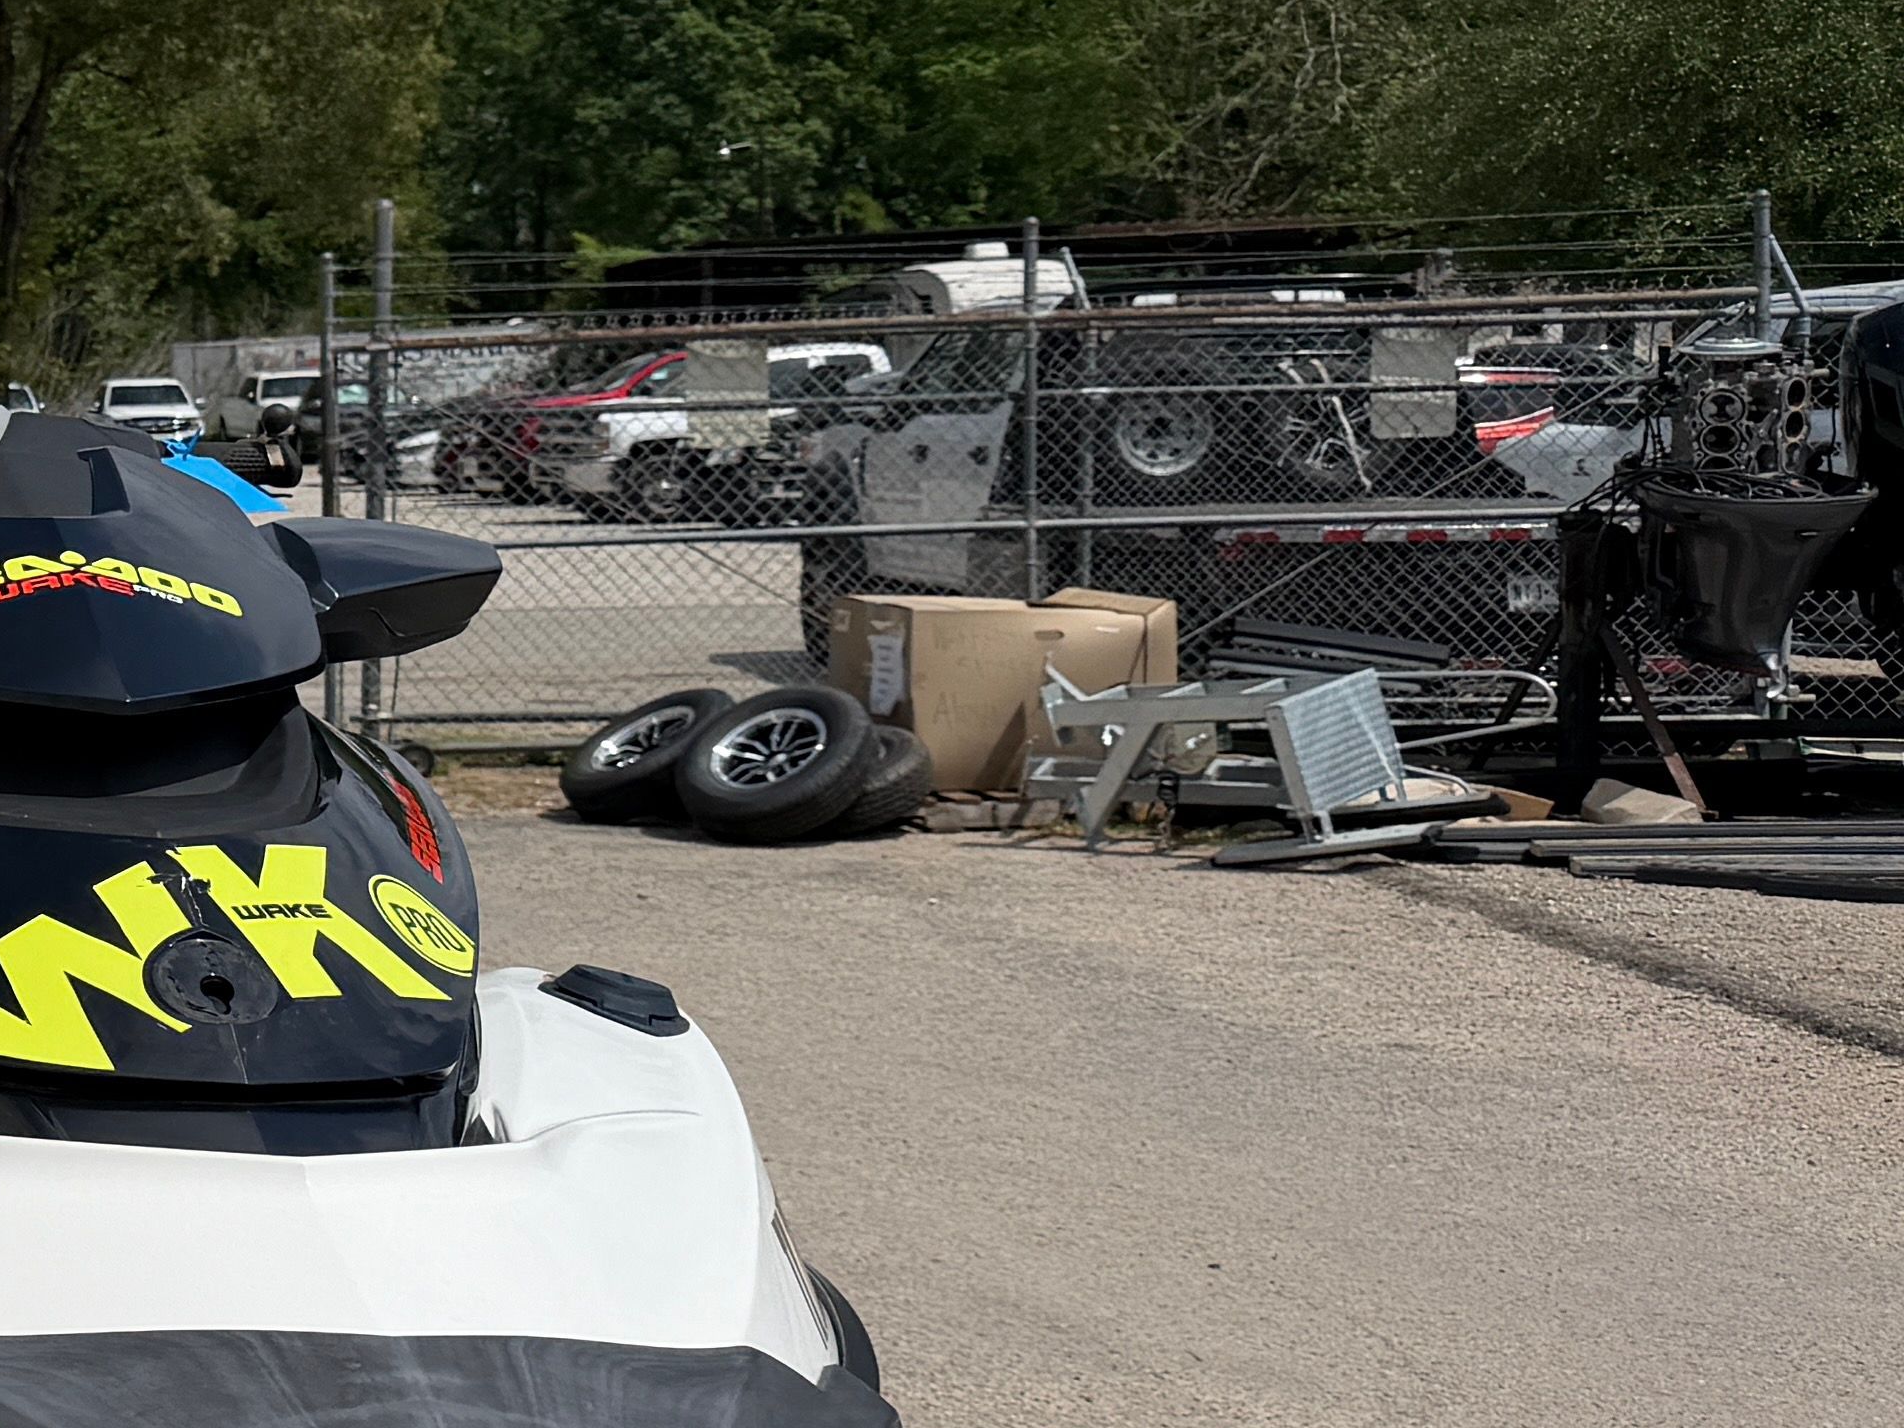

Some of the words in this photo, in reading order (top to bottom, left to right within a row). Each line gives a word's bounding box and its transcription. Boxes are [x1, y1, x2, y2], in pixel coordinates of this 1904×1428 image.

[132, 583, 185, 604] PRO
[231, 903, 333, 921] WAKE
[388, 901, 467, 953] PRO
